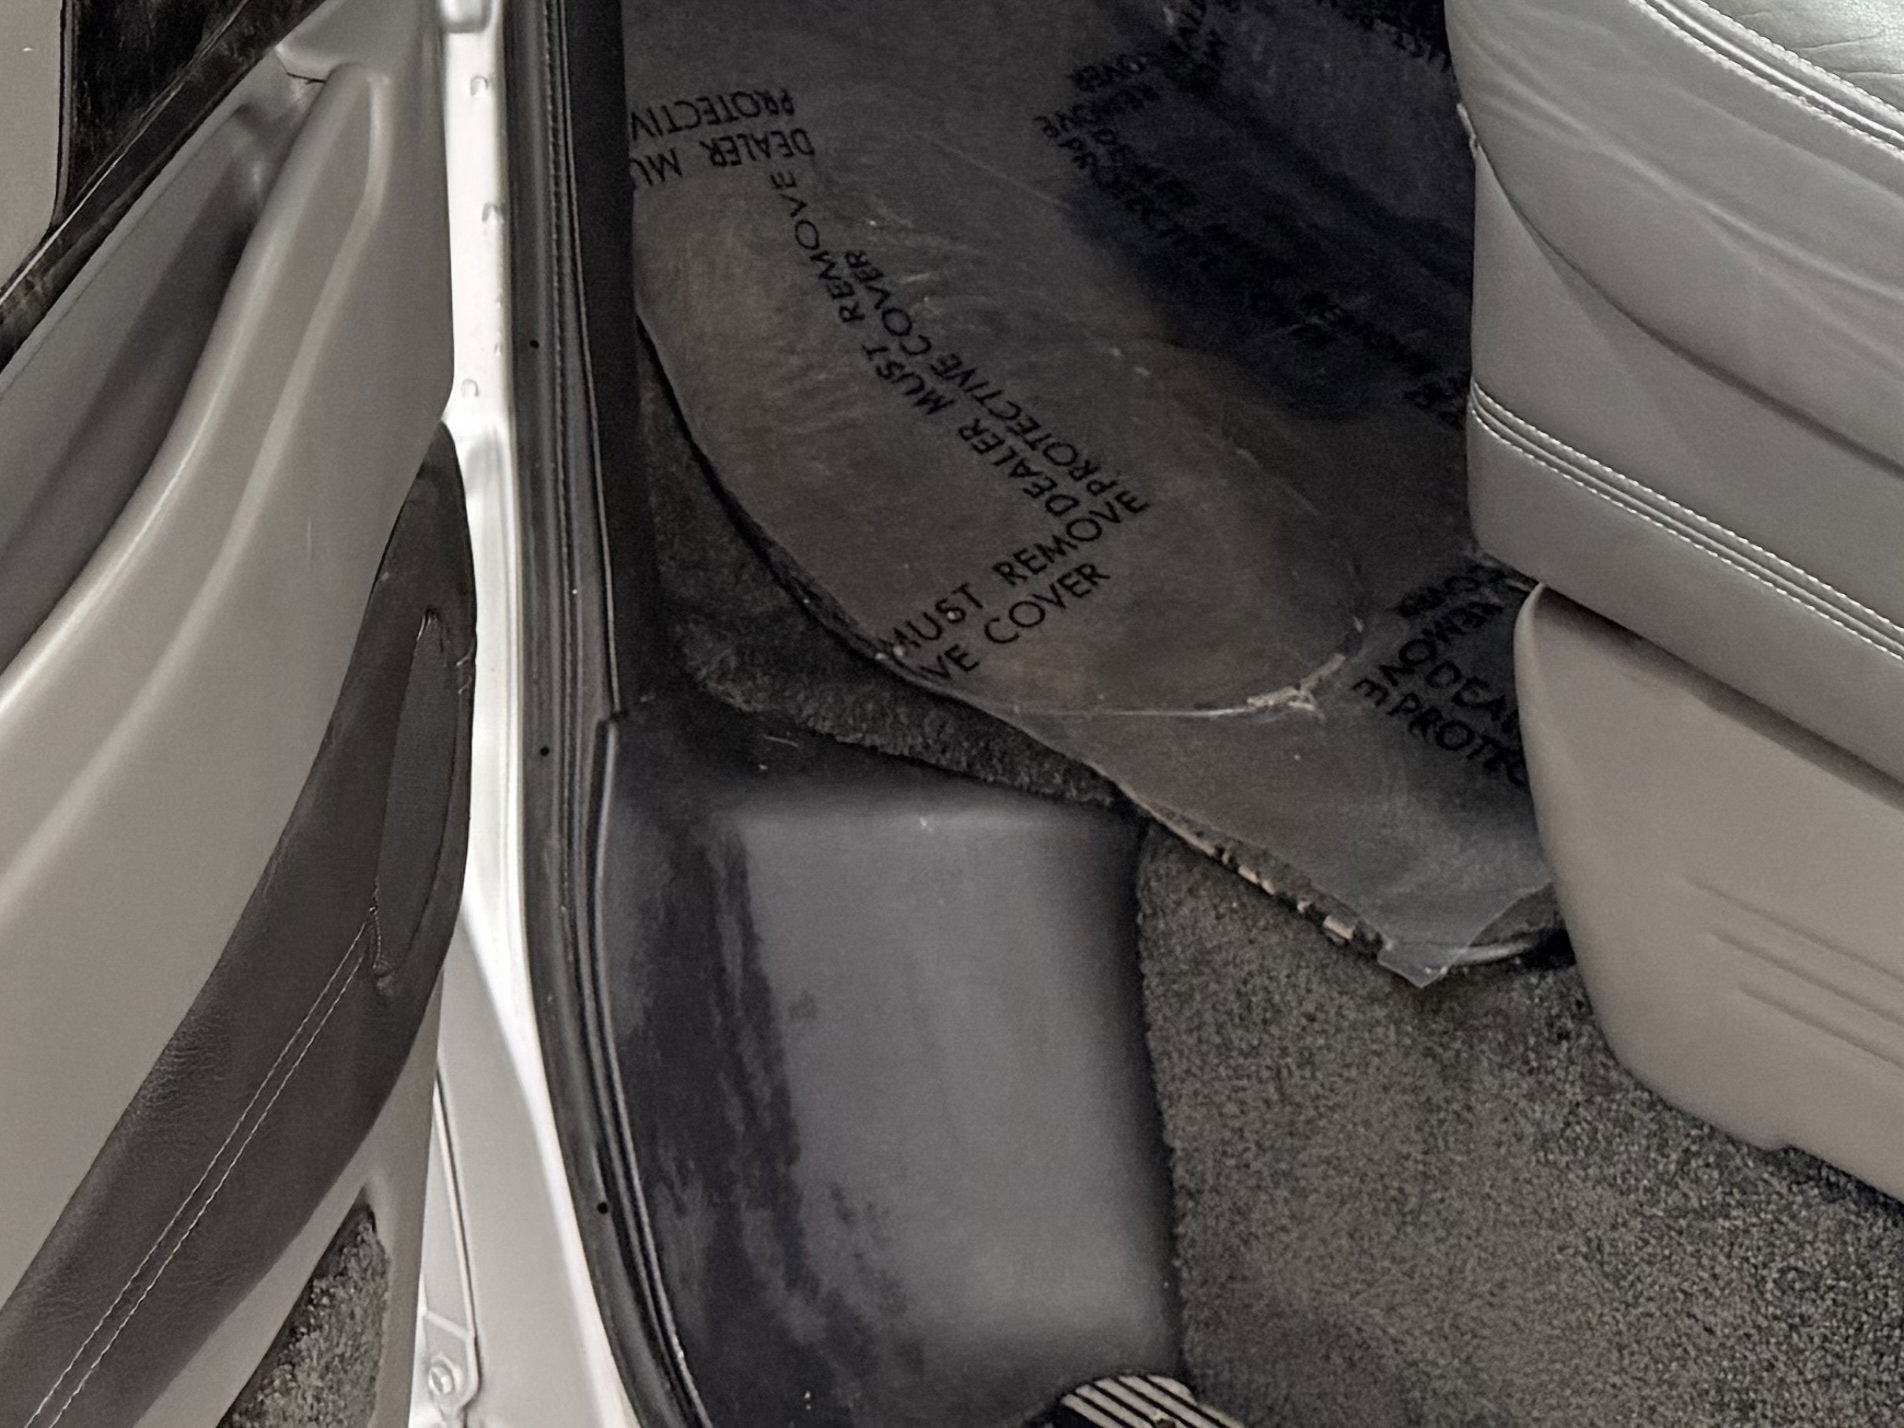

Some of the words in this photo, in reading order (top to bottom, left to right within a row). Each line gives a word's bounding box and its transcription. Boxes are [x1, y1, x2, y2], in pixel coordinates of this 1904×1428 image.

[630, 88, 795, 141] PROTECTIV
[699, 128, 815, 167] DEALER
[770, 169, 866, 324] REMOVE
[843, 248, 933, 358] COVER
[861, 342, 955, 416] MUST
[929, 352, 1119, 496] PROTECTIVE
[957, 417, 1081, 518] DEALER
[991, 489, 1150, 586] REMOVE
[983, 562, 1112, 644] COVER
